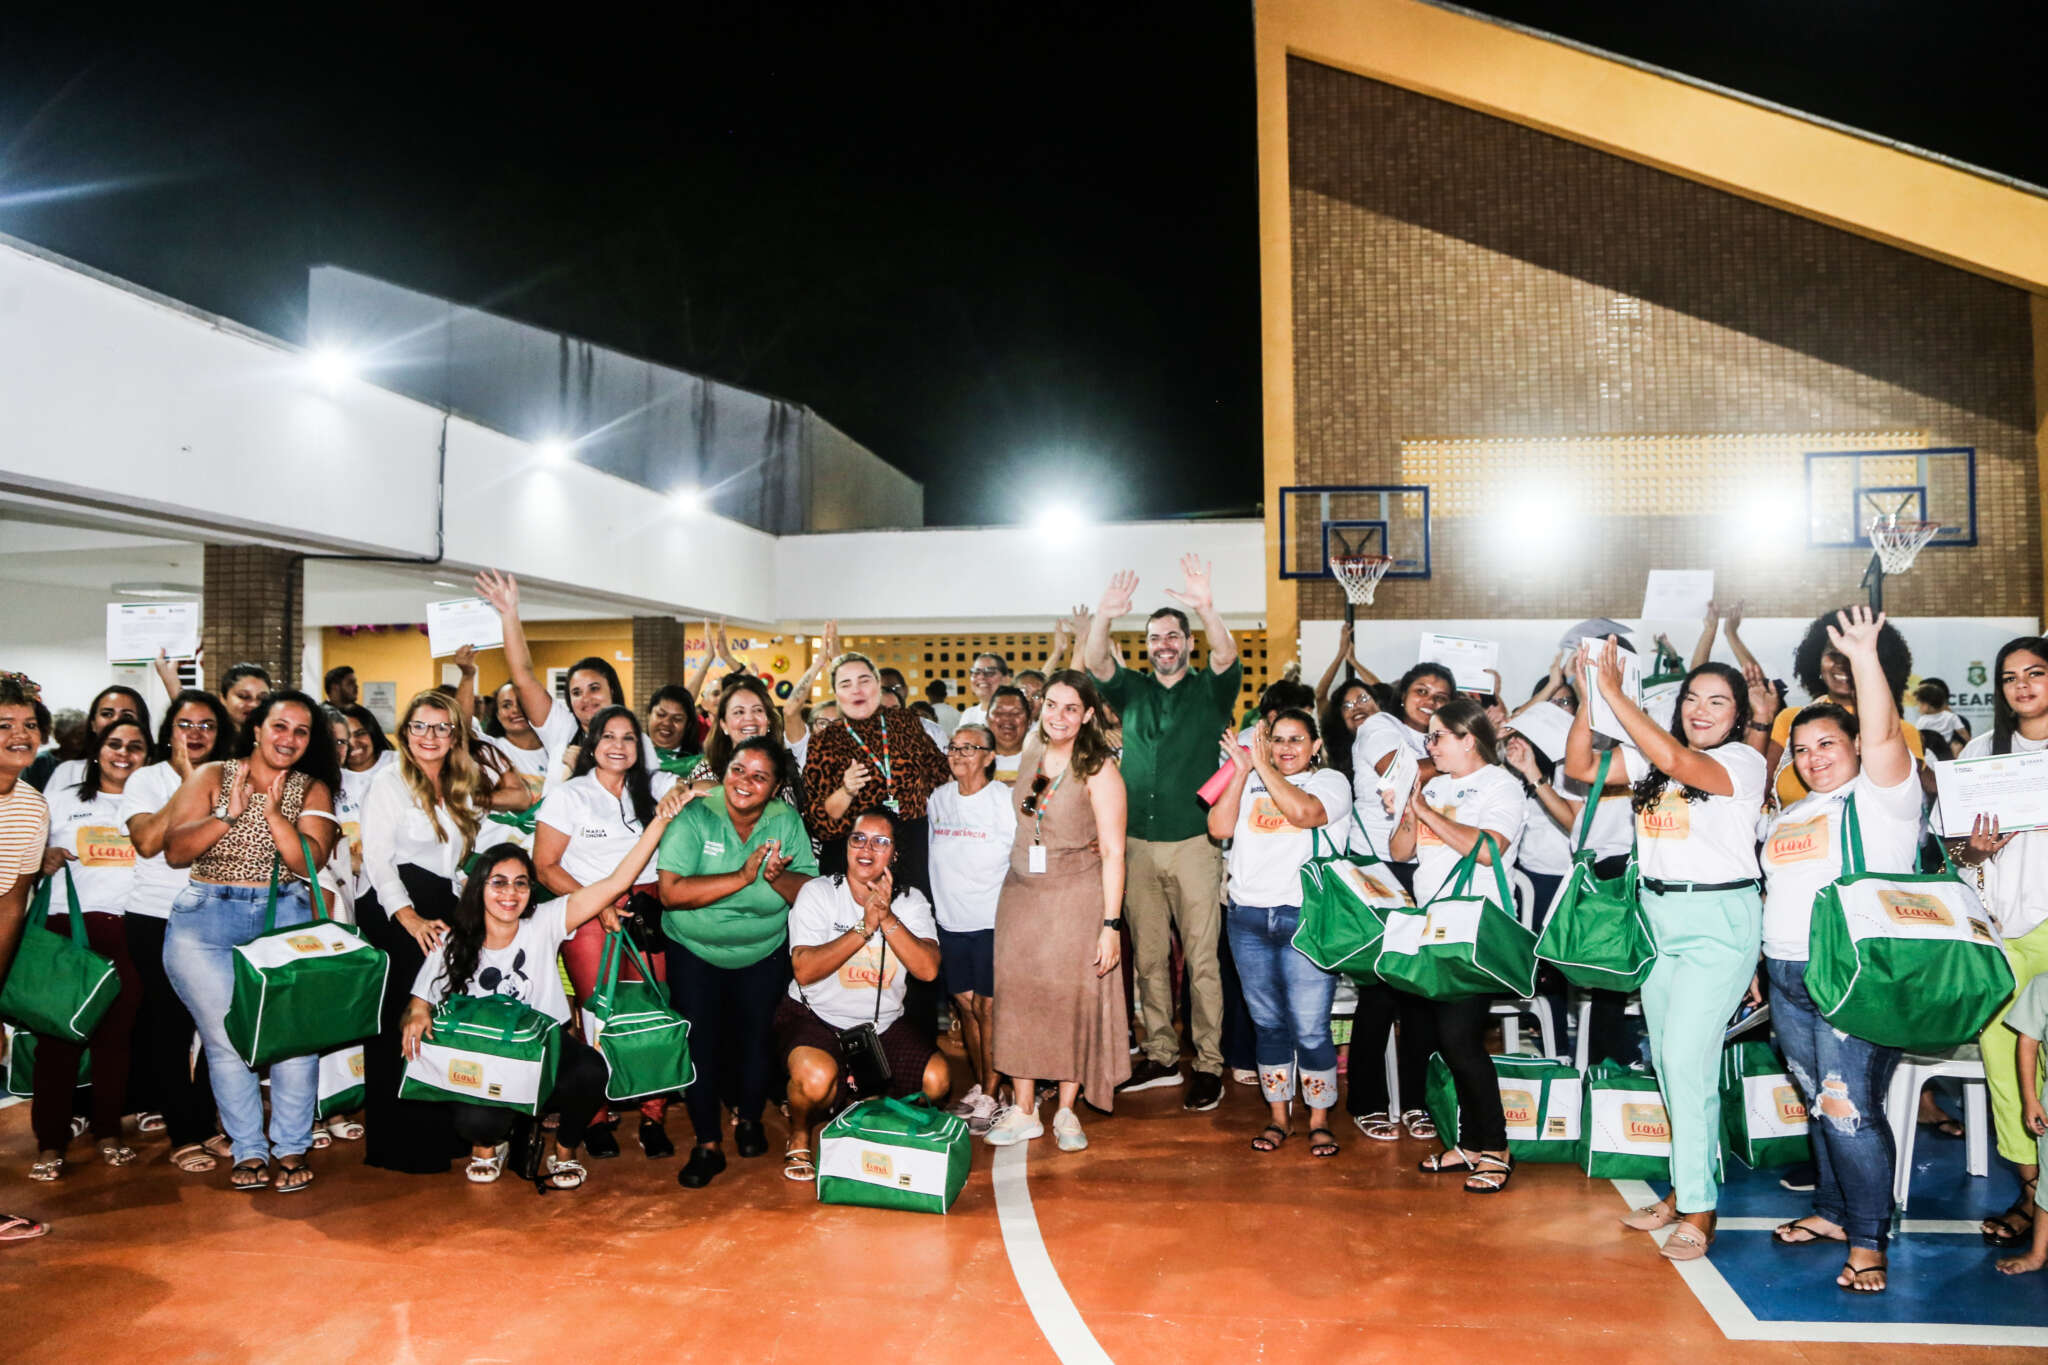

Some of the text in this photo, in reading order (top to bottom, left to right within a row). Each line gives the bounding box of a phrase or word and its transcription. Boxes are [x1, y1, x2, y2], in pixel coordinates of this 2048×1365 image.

[732, 638, 749, 651] DO
[1947, 693, 1996, 706] CEAR
[1895, 906, 1938, 919] Ceará
[1631, 1121, 1665, 1135] Ceará
